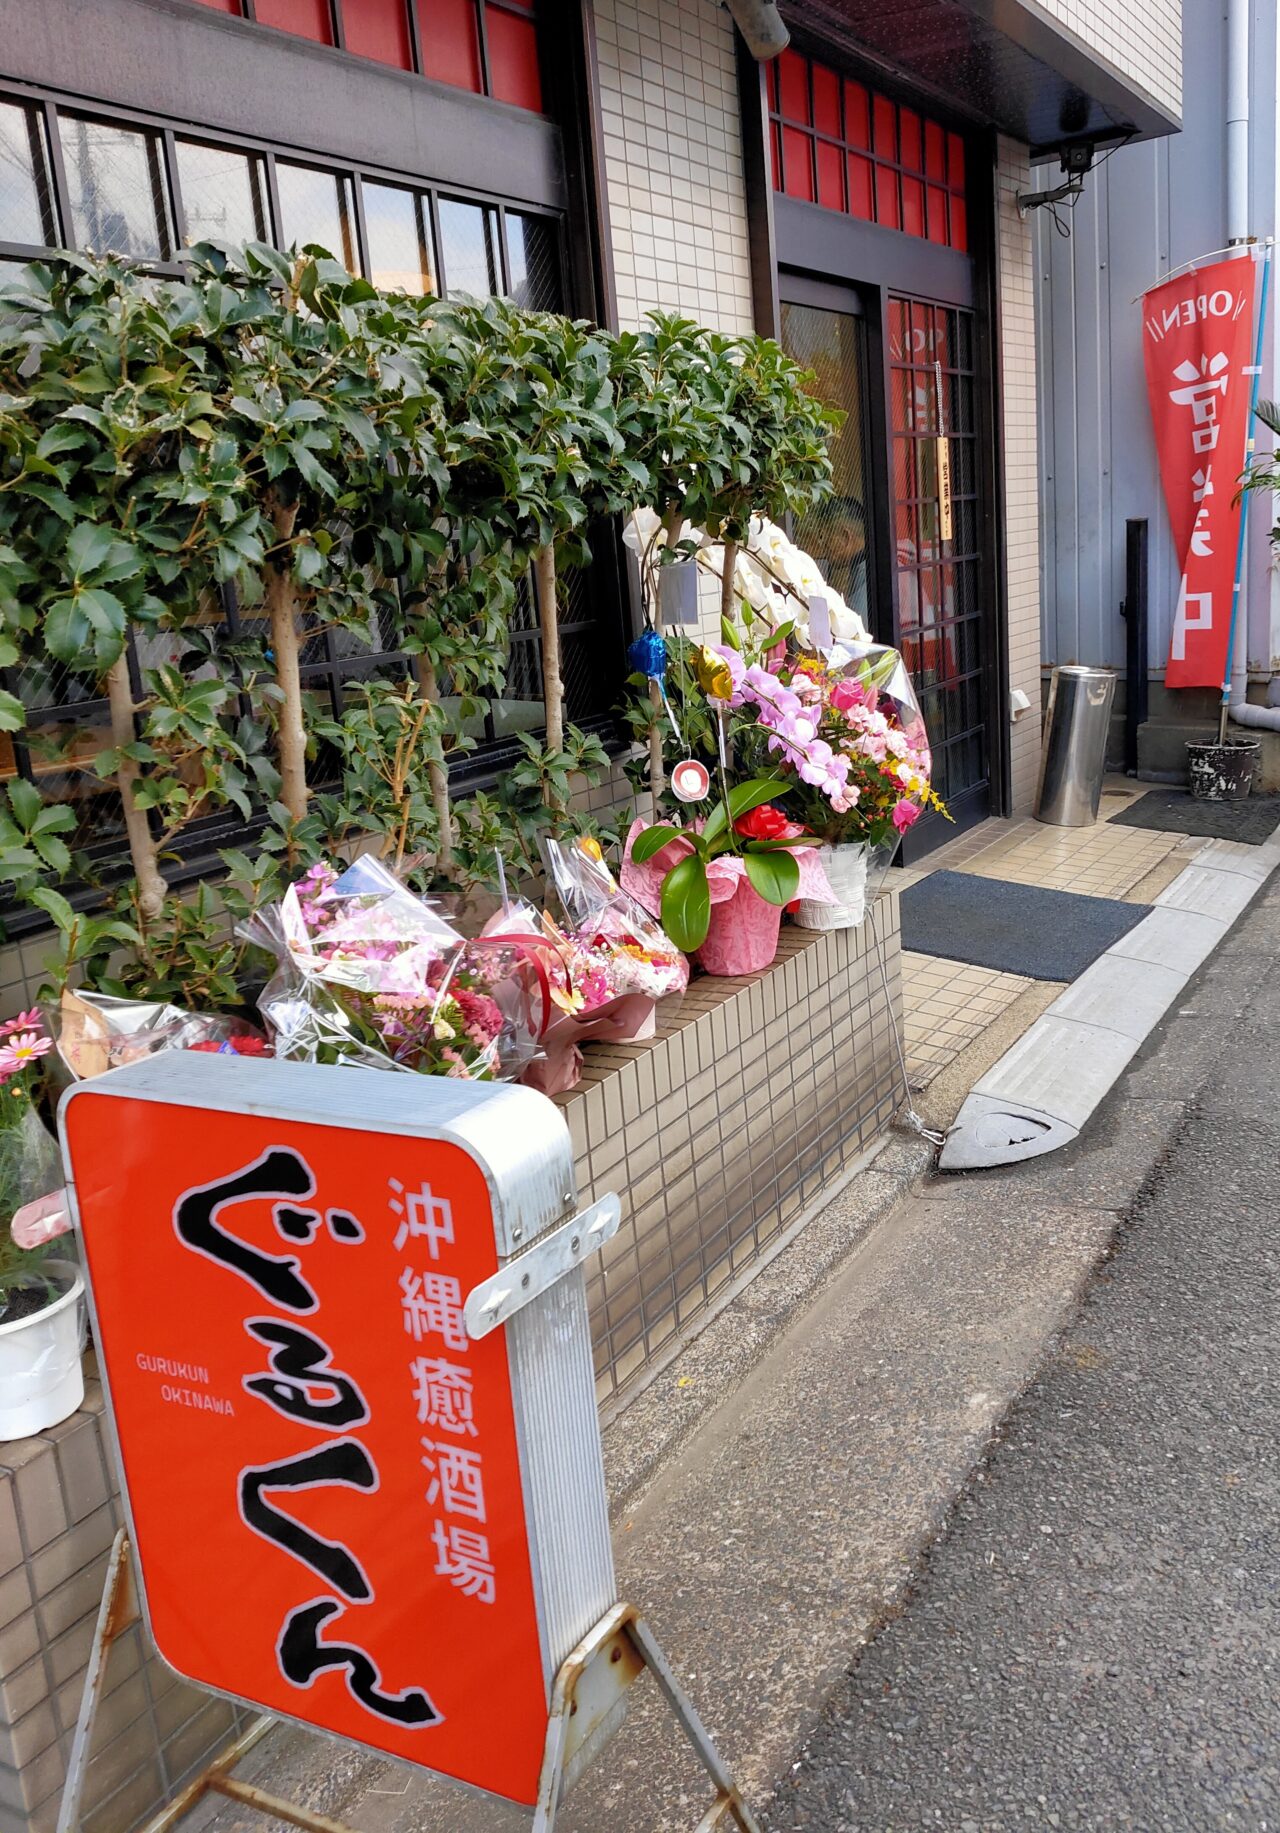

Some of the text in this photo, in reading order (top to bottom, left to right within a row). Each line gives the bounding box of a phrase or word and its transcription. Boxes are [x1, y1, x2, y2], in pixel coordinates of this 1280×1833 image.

[135, 1353, 210, 1384] GURUKUN
[160, 1384, 236, 1417] OKINAWA
[172, 1144, 446, 1730] ぐるくん
[387, 1176, 497, 1605] 沖縄癒酒場
